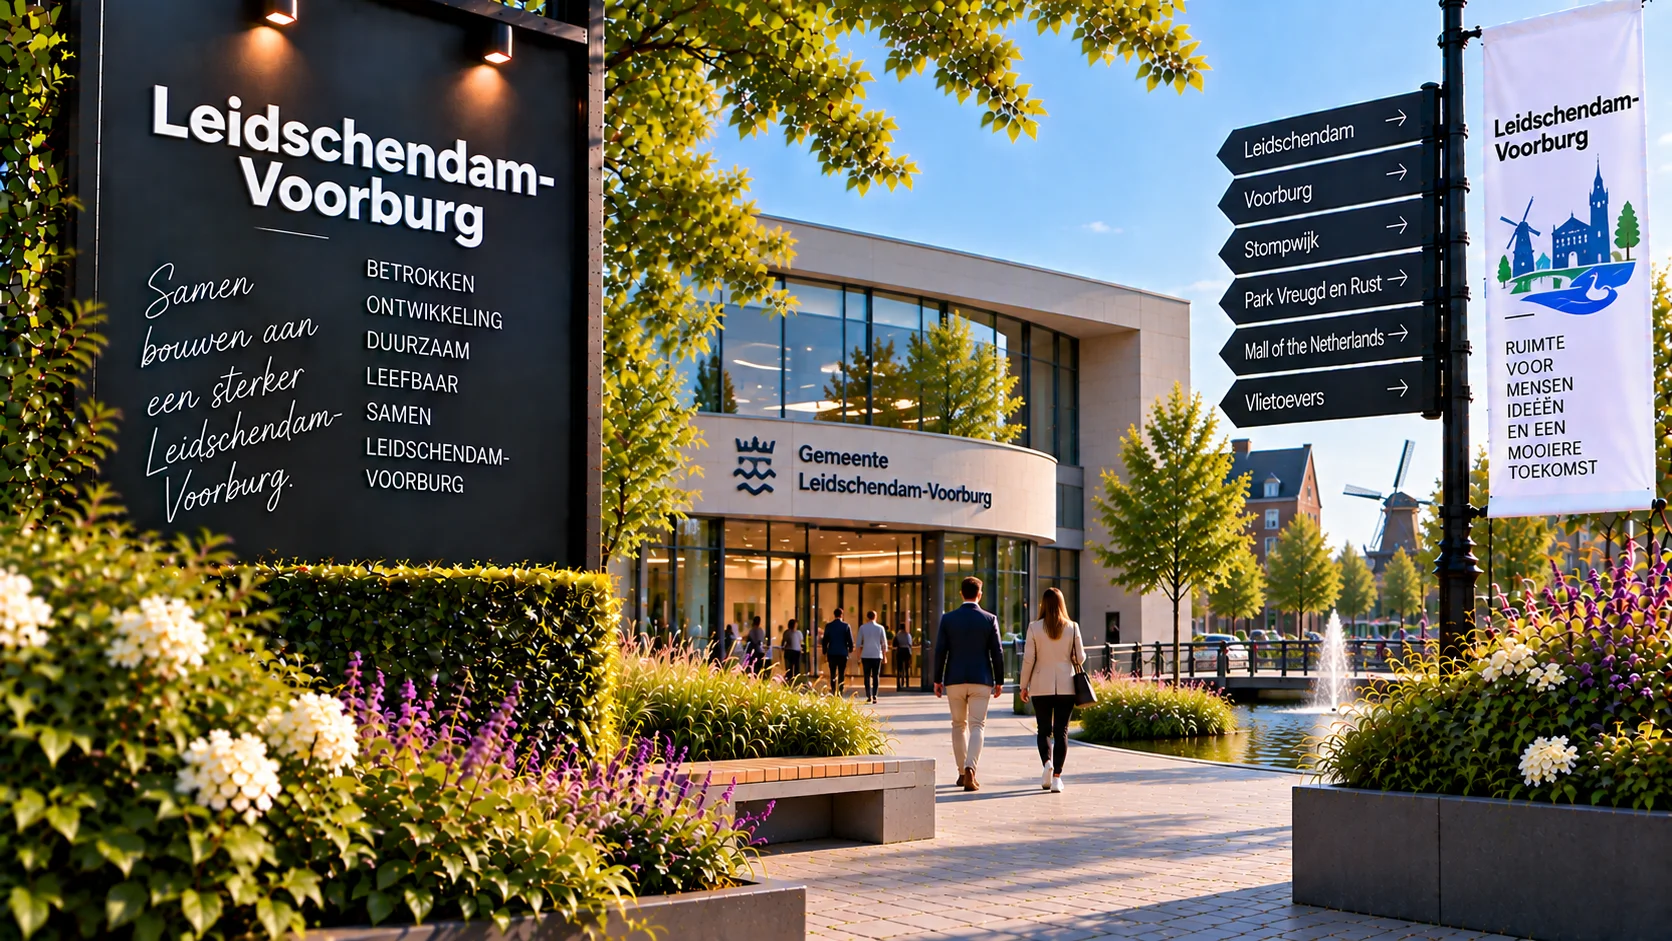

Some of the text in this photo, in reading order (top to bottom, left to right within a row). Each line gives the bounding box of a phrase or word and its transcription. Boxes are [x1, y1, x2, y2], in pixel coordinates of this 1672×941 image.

[1494, 94, 1640, 138] Leidschendam-
[153, 84, 555, 197] Leidschendam-
[1244, 124, 1354, 158] Leidschendam
[1494, 129, 1589, 162] Voorburg
[238, 155, 484, 248] Voorburg
[1244, 184, 1312, 209] Voorburg
[1244, 230, 1320, 259] Stompwijk
[145, 262, 255, 319] Samen
[367, 259, 475, 293] BETROKKEN
[1245, 274, 1383, 309] Park Vreugd en Rust
[366, 295, 503, 330] ONTWIKKELING
[140, 318, 319, 368] bouwen aan
[367, 330, 470, 360] DUURZAAM
[1245, 327, 1385, 360] Mall of the Netherlands
[1505, 335, 1566, 356] RUIMTE
[367, 366, 459, 394] LEEFBAAR
[1505, 357, 1554, 377] VOOR
[147, 355, 305, 417] een sterker
[1245, 391, 1325, 412] Vlietoevers
[1506, 376, 1573, 397] MENSEN
[366, 402, 431, 426] SAMEN
[1507, 419, 1566, 439] EN EEN
[146, 399, 343, 477] Leidschendam-
[366, 436, 510, 466] LEIDSCHENDAM-
[1508, 440, 1582, 460] MOOIERE
[798, 444, 889, 470] Gemeente
[1508, 459, 1598, 480] TOEKOMST
[166, 460, 293, 524] Voorburg.
[365, 468, 464, 494] VOORBURG
[798, 472, 992, 509] Leidschendam-Voorburg
